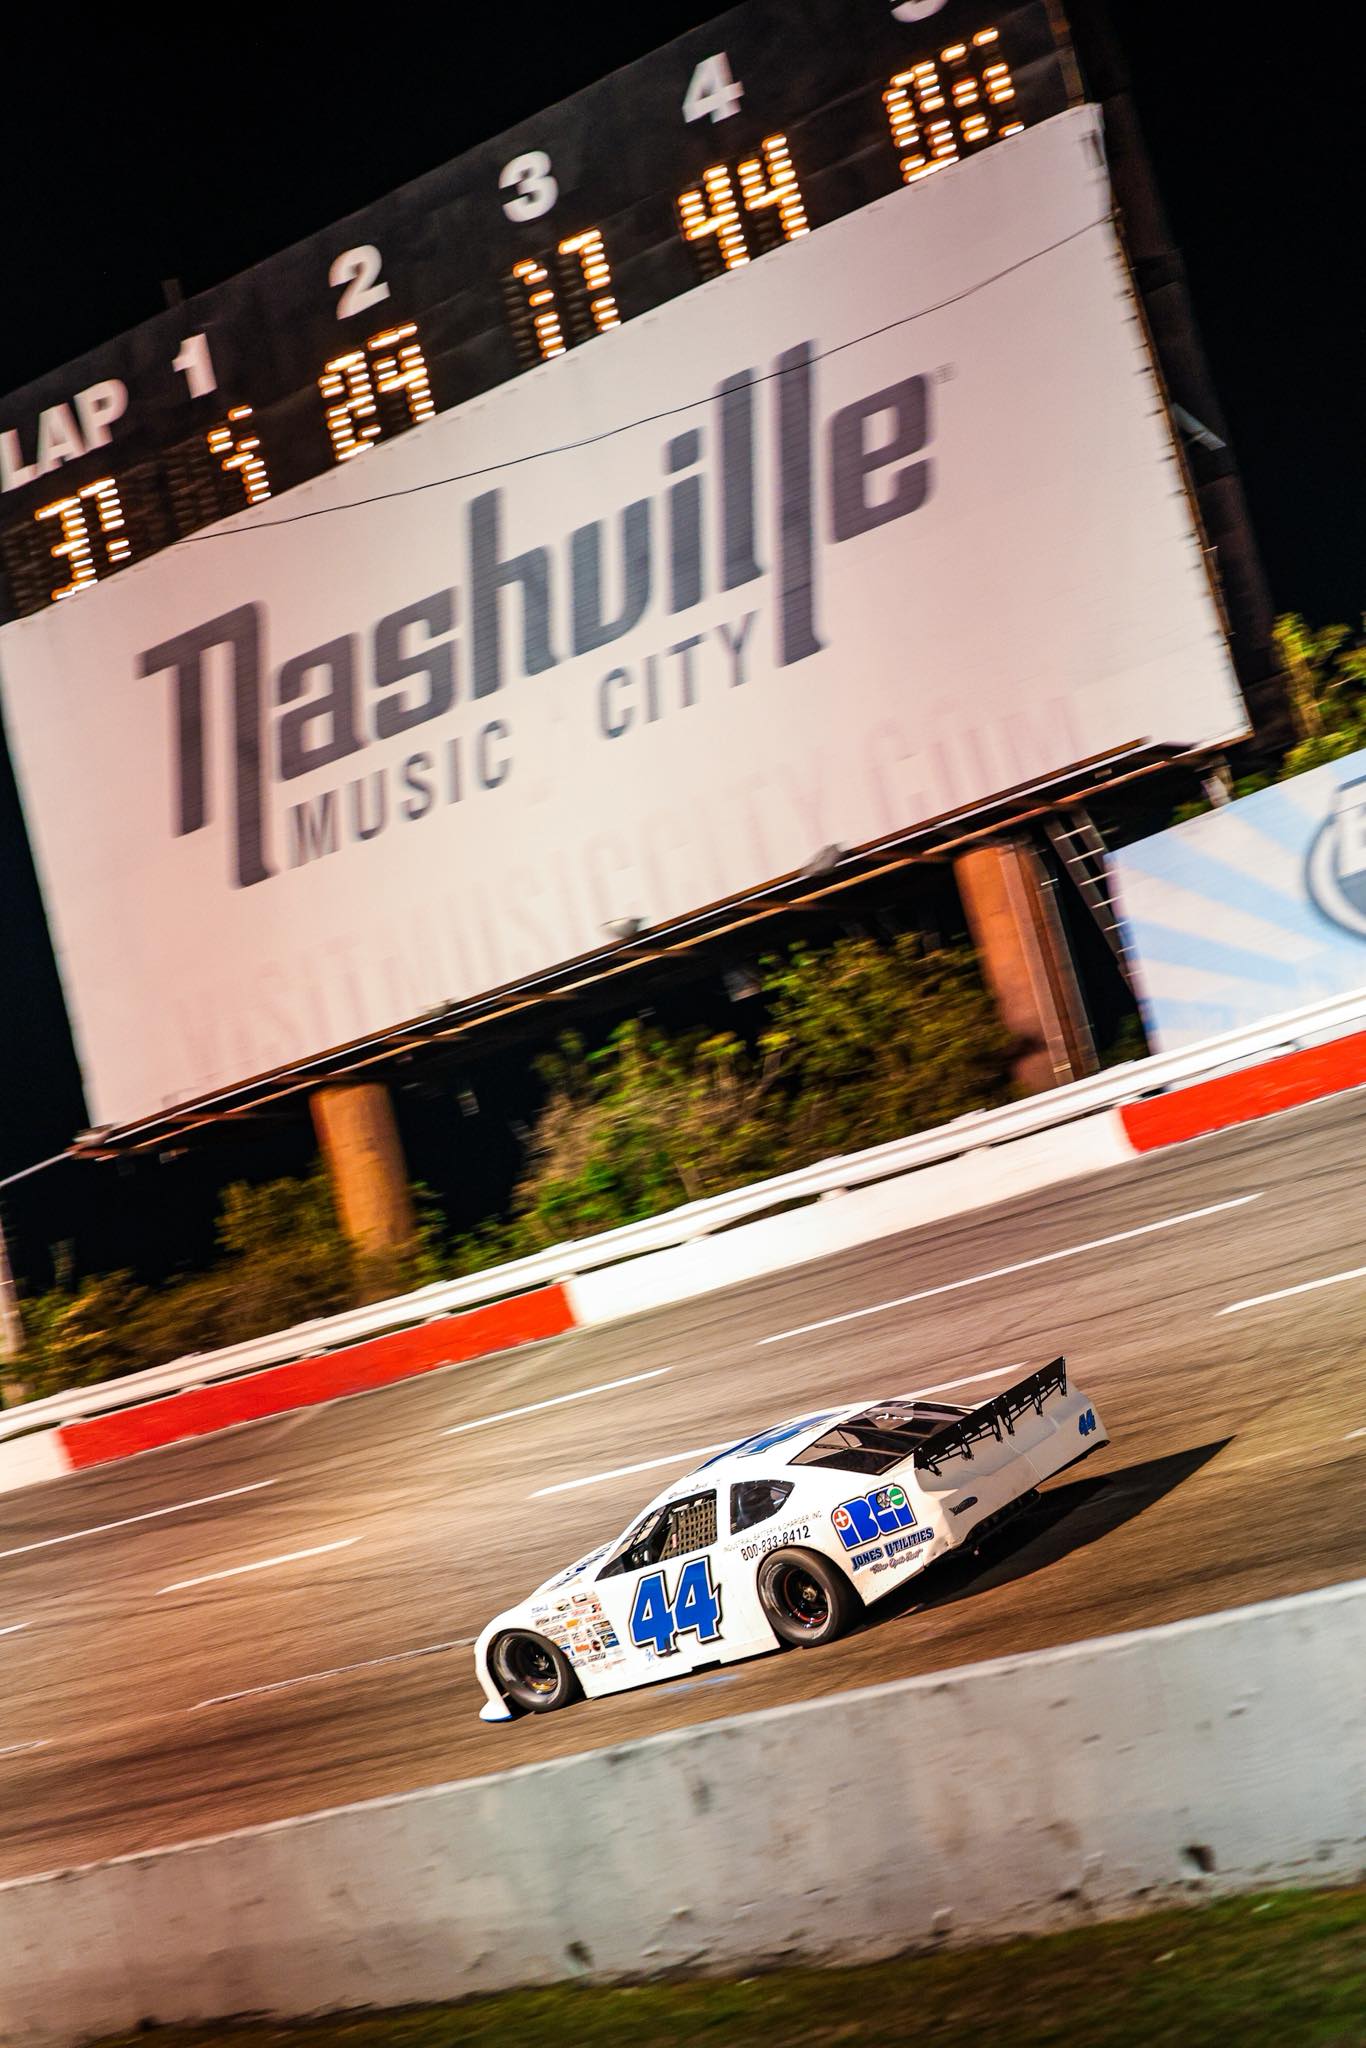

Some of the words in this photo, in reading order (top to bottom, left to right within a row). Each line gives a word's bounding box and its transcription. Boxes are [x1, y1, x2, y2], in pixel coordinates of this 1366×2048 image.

[682, 51, 744, 123] 4
[499, 151, 559, 223] 3
[678, 133, 810, 270] 44
[329, 244, 390, 319] 2
[172, 333, 217, 398] 1
[0, 379, 128, 492] LAP
[287, 718, 512, 868] MUSIC
[597, 610, 757, 740] CITY
[741, 1525, 811, 1561] 800-833-8412
[851, 1547, 882, 1571] JONES
[885, 1526, 935, 1557] UTILITIES
[628, 1554, 723, 1657] 44
